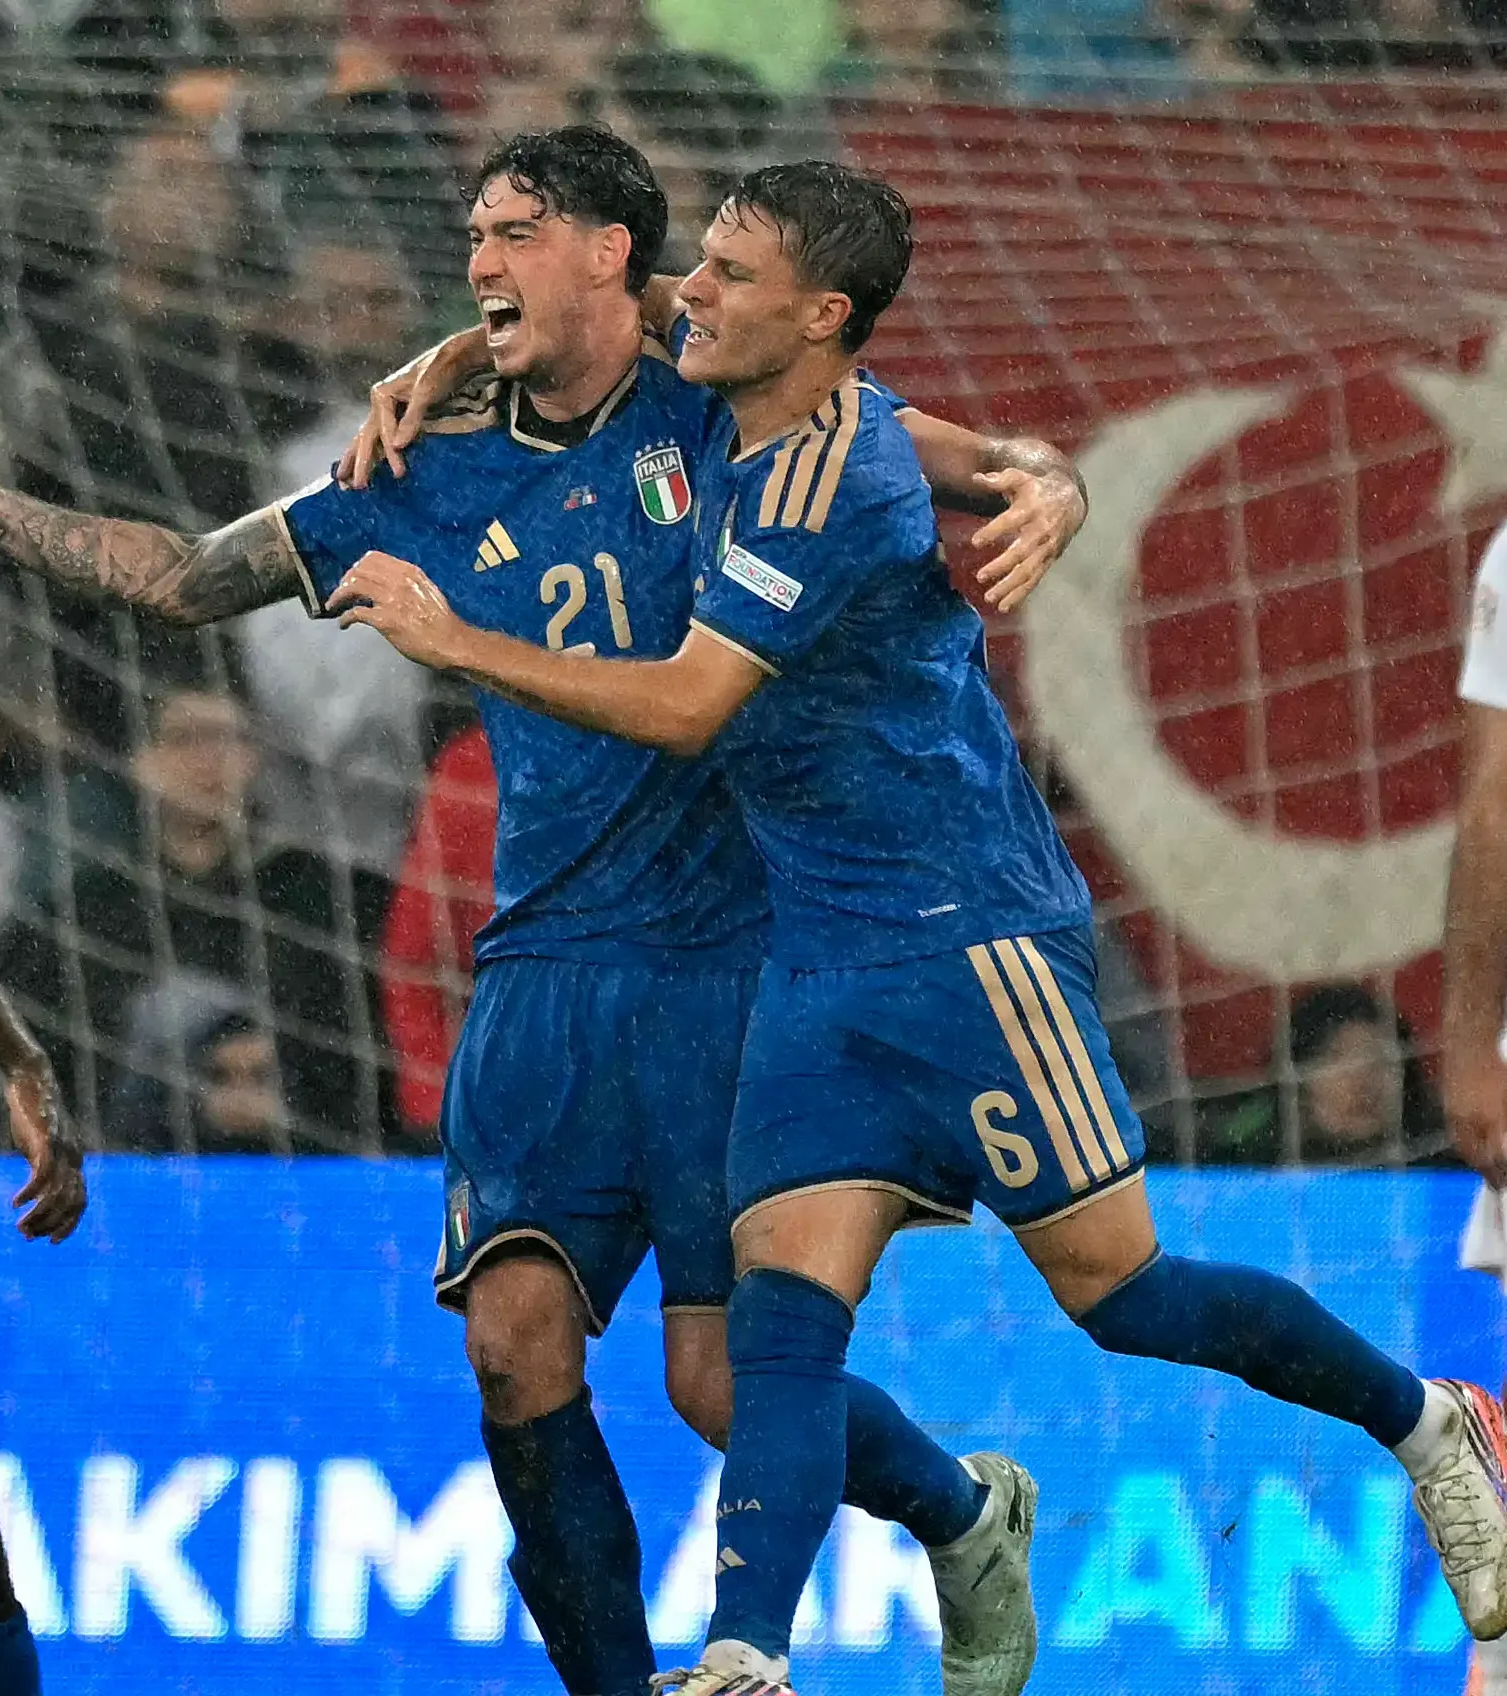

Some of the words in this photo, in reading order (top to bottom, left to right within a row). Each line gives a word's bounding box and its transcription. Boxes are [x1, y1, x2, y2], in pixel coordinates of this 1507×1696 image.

[637, 453, 678, 479] ITALIA
[540, 552, 633, 658] 21
[728, 555, 798, 602] FOUNDATION
[970, 1090, 1040, 1189] 6
[1051, 1470, 1479, 1653] AN
